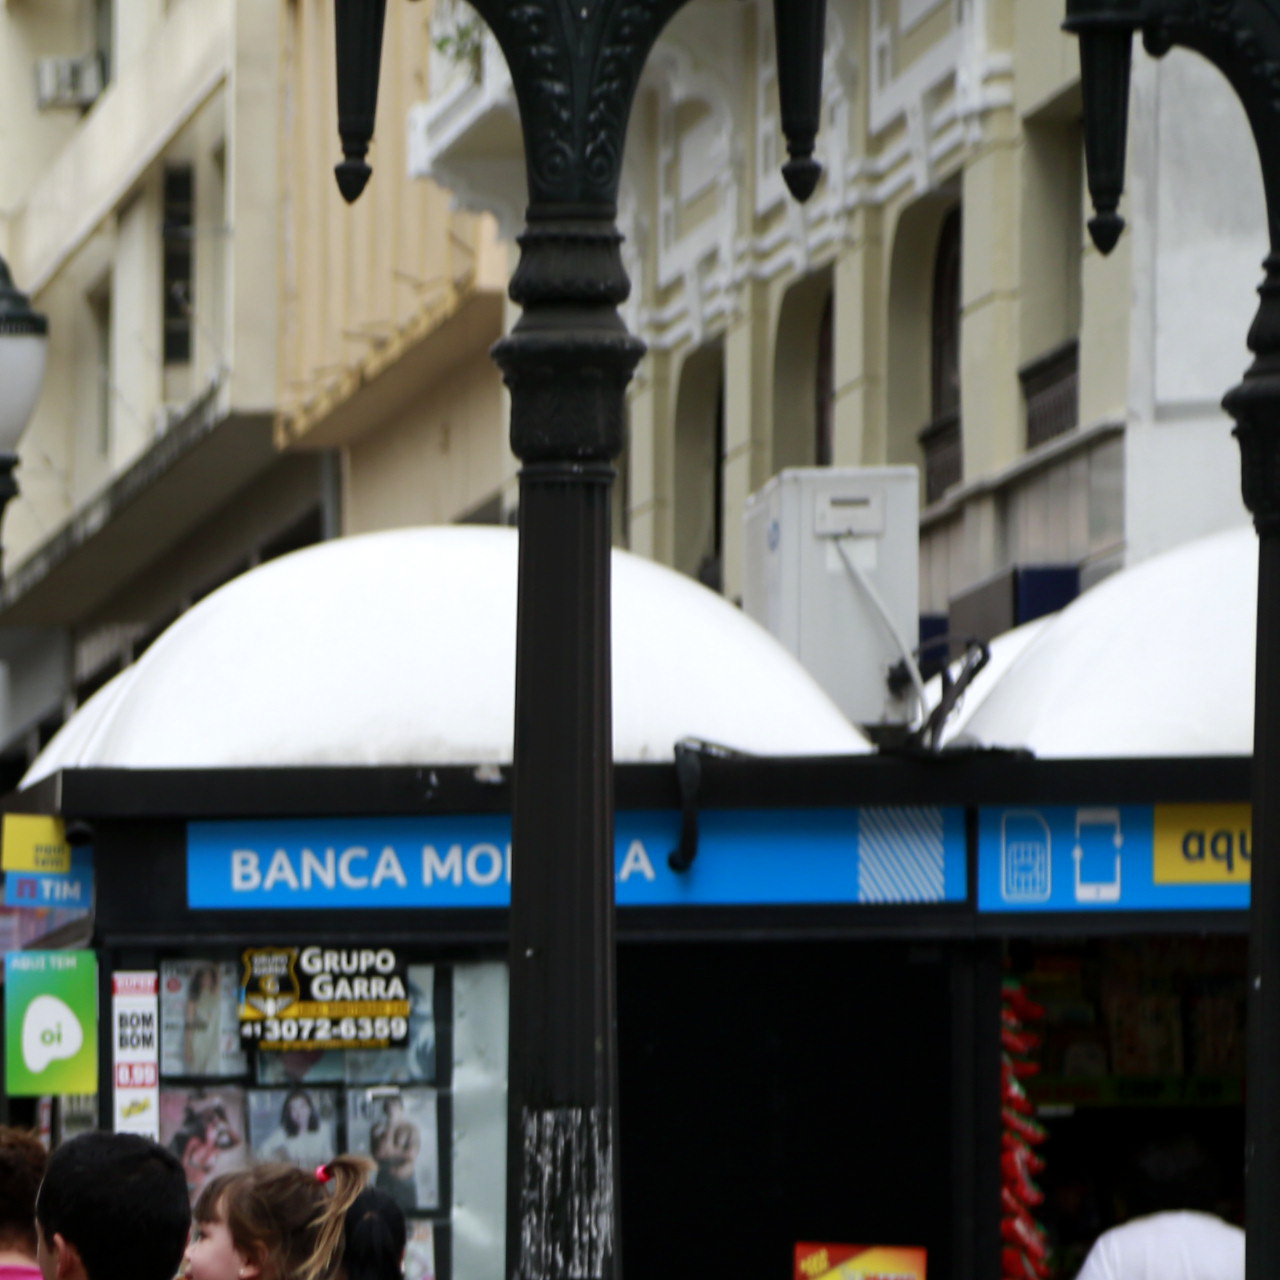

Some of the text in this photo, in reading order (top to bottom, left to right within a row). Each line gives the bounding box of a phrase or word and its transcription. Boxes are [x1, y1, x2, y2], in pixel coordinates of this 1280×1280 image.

[1182, 828, 1252, 873] aqu
[231, 846, 407, 892] BANCA
[42, 879, 82, 901] TIM
[300, 946, 396, 974] GRUPO
[311, 973, 406, 1000] GARRA
[40, 1020, 63, 1047] oi
[118, 1012, 154, 1029] BOM
[265, 1016, 408, 1041] 3072-6359
[118, 1031, 154, 1049] BOM
